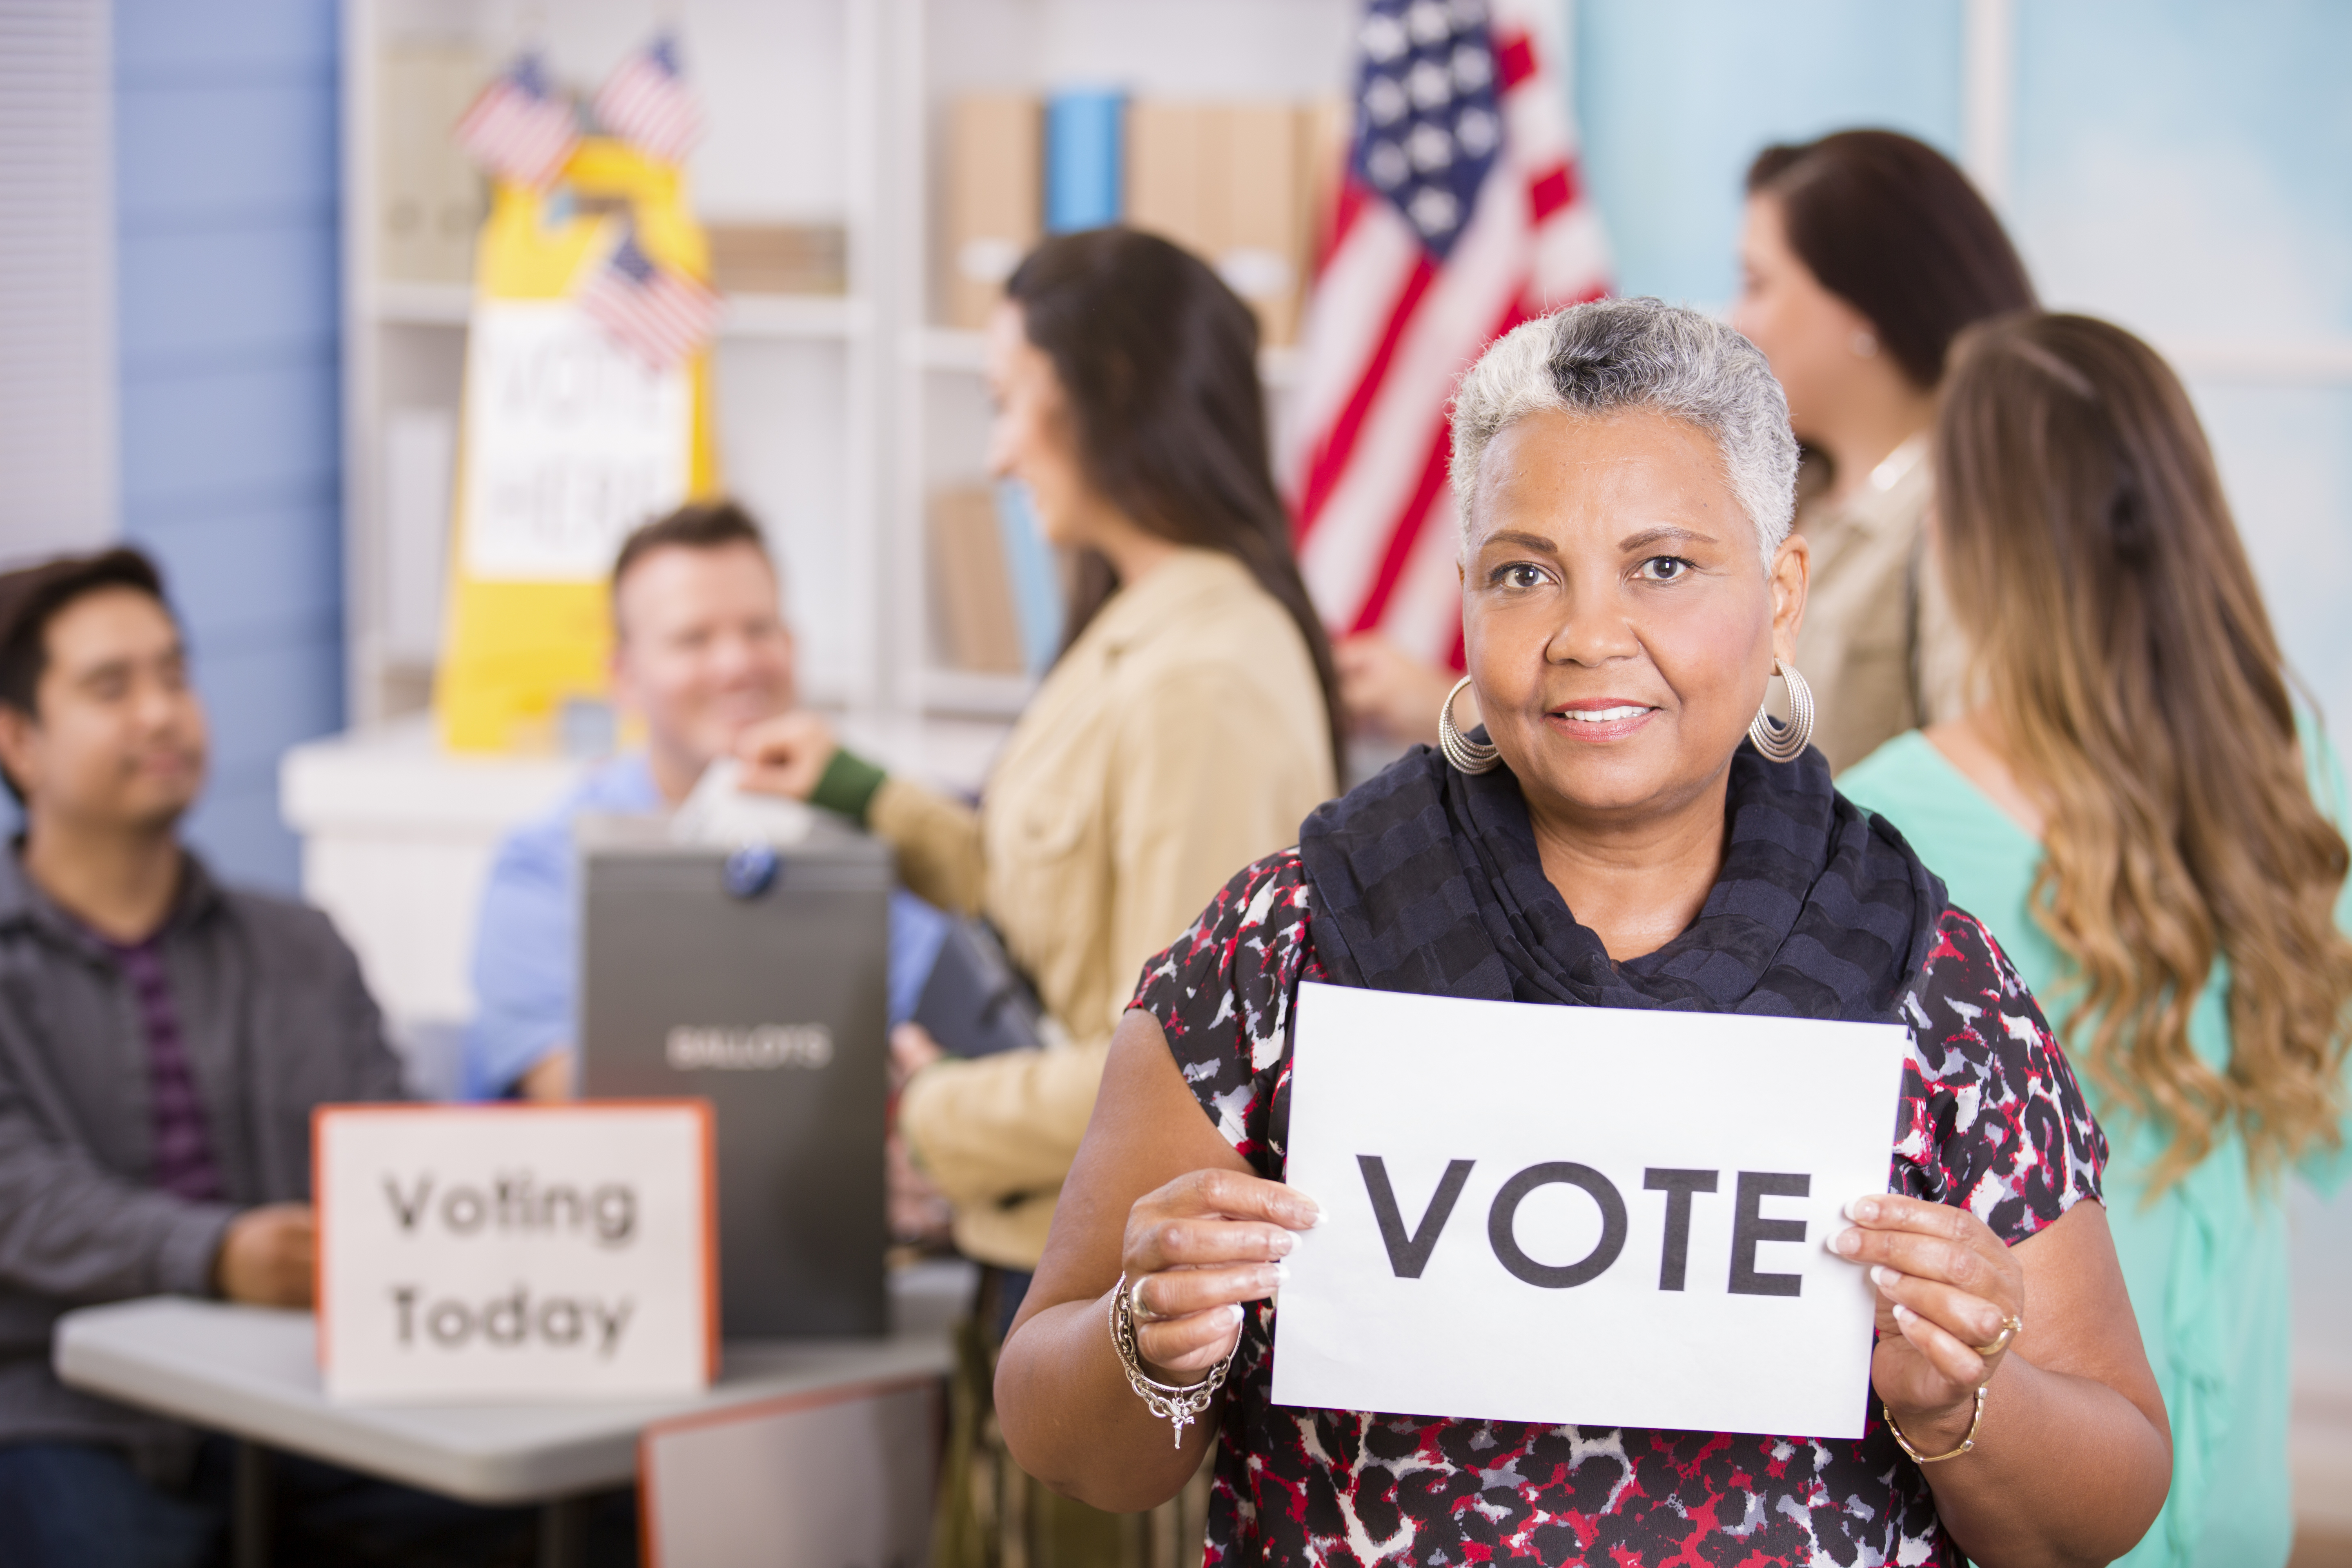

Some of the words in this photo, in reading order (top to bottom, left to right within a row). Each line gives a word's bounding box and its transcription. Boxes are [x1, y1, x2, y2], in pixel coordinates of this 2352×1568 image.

[382, 1171, 638, 1251] Voting
[1356, 1155, 1811, 1296] VOTE
[389, 1283, 636, 1362] Today
[1113, 1341, 1133, 1371] though
